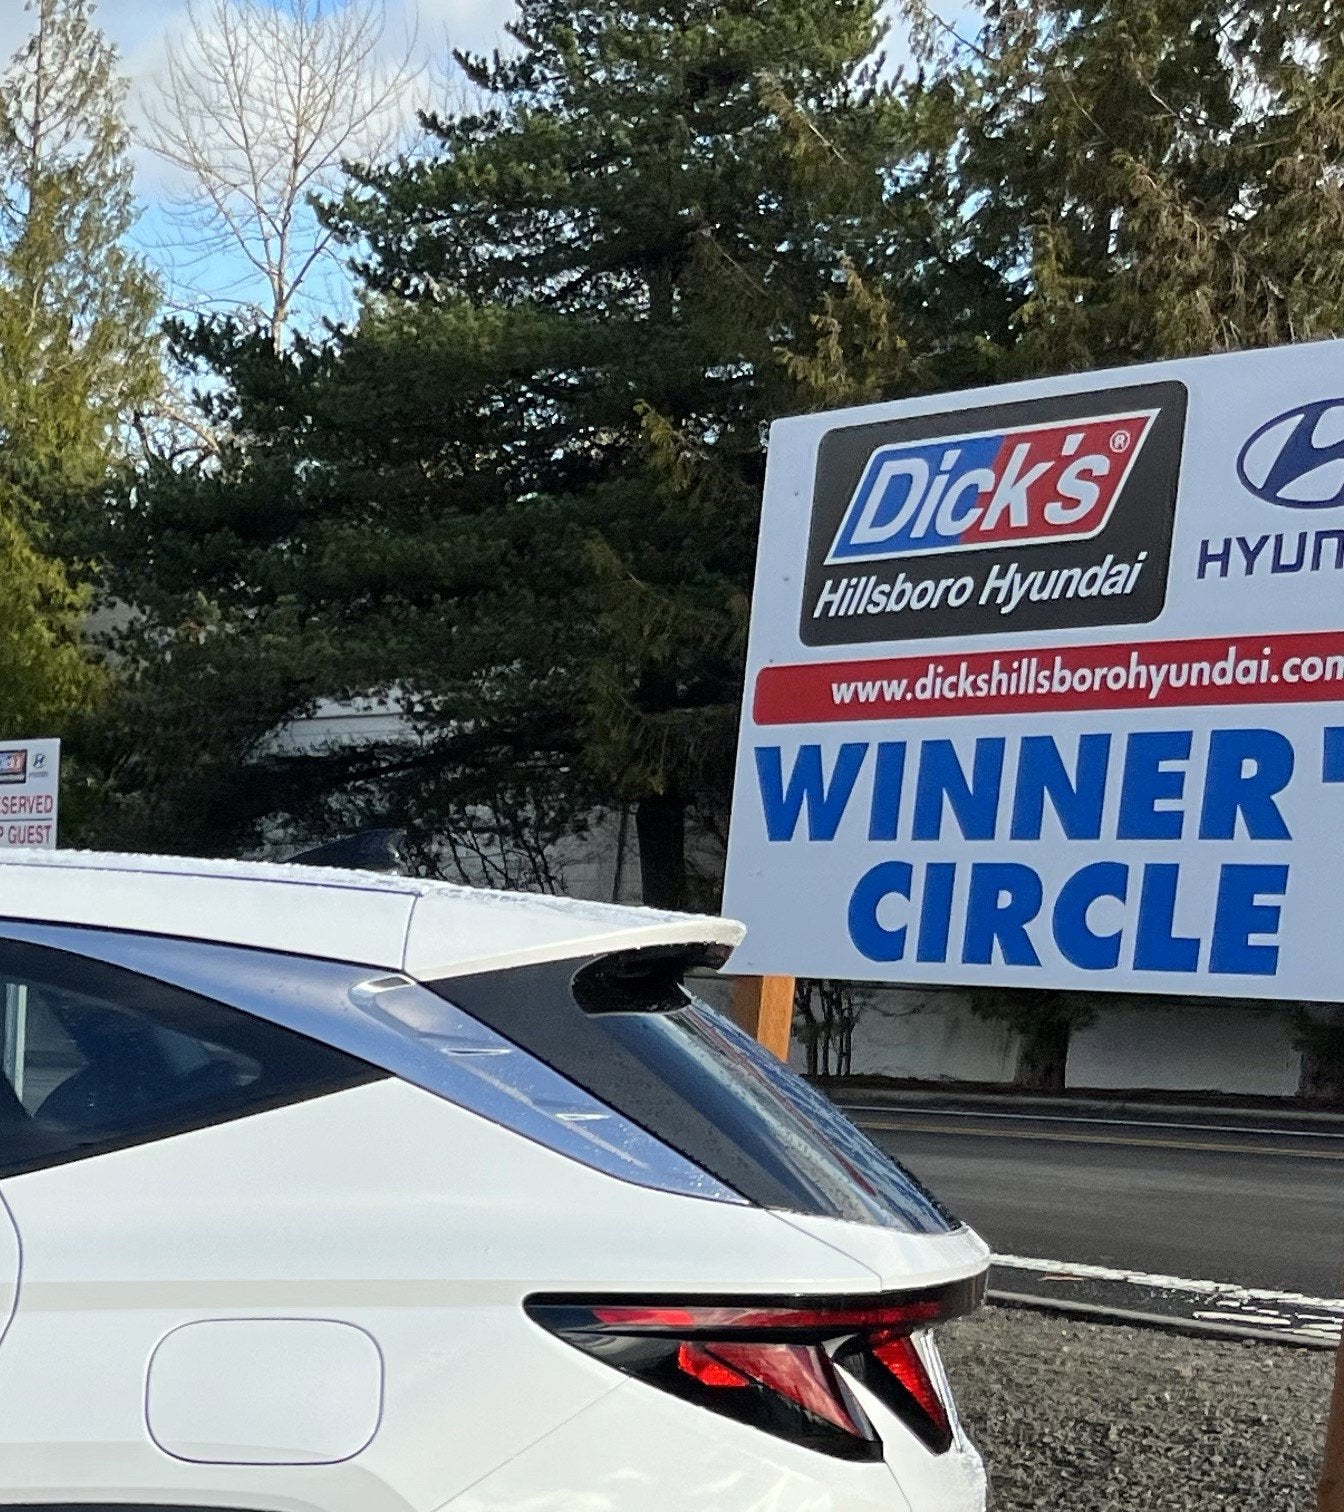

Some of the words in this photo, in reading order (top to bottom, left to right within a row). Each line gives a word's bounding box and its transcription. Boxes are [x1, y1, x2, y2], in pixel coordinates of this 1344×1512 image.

[813, 573, 974, 619] Hillsboro
[979, 552, 1148, 614] Hyundai
[8, 825, 52, 844] GUEST
[848, 861, 1290, 976] CIRCLE
